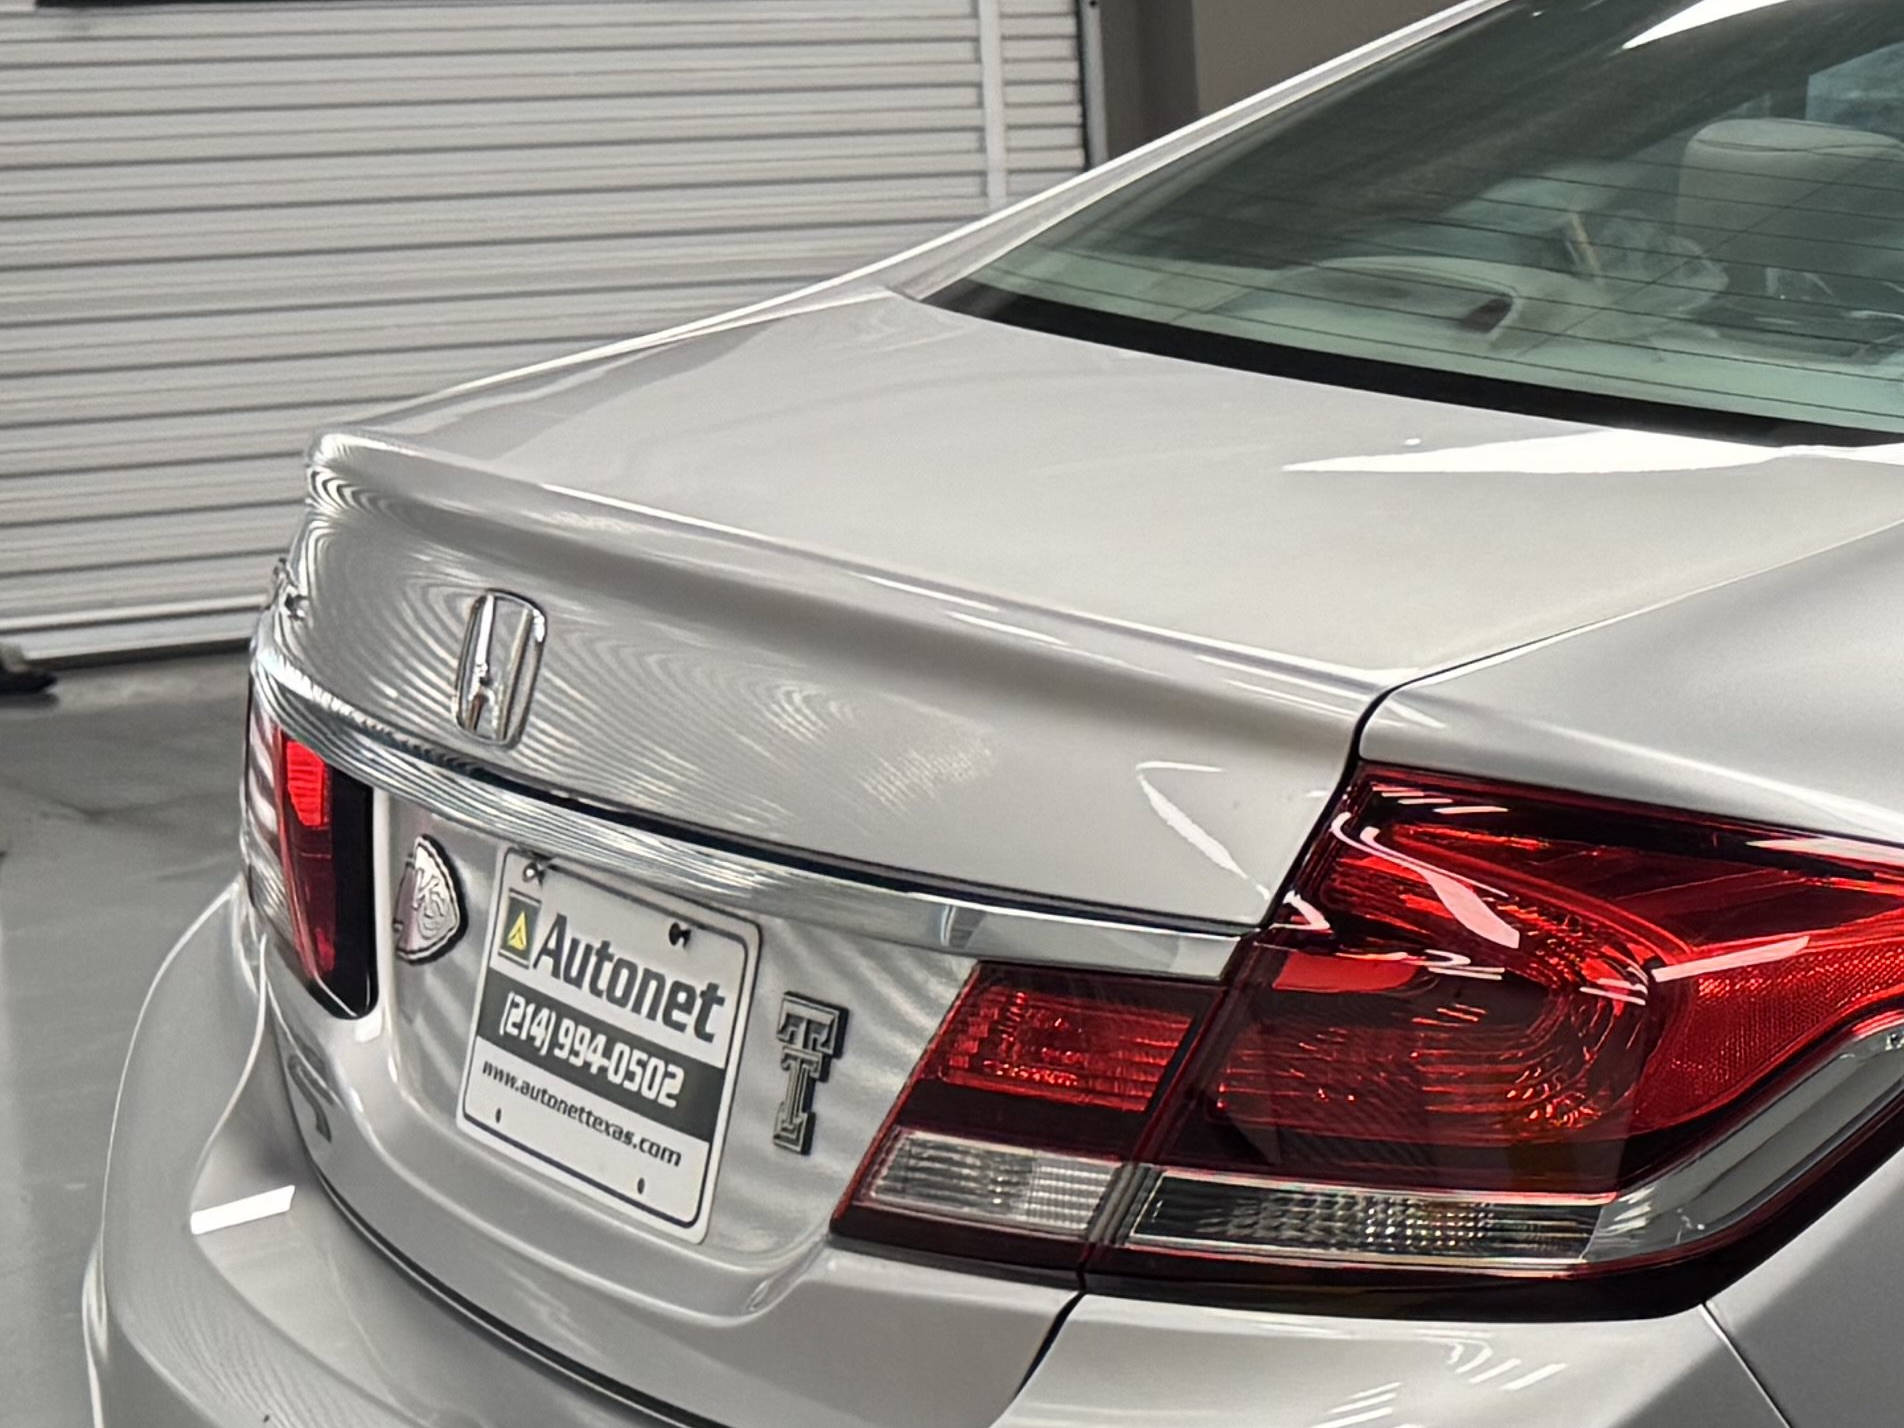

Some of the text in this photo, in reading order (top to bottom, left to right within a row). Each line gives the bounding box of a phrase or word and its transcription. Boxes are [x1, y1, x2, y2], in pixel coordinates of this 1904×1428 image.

[533, 912, 726, 1044] Autonet
[499, 991, 685, 1109] (214) 994-0502
[481, 1059, 683, 1167] www.autonettexas.com
